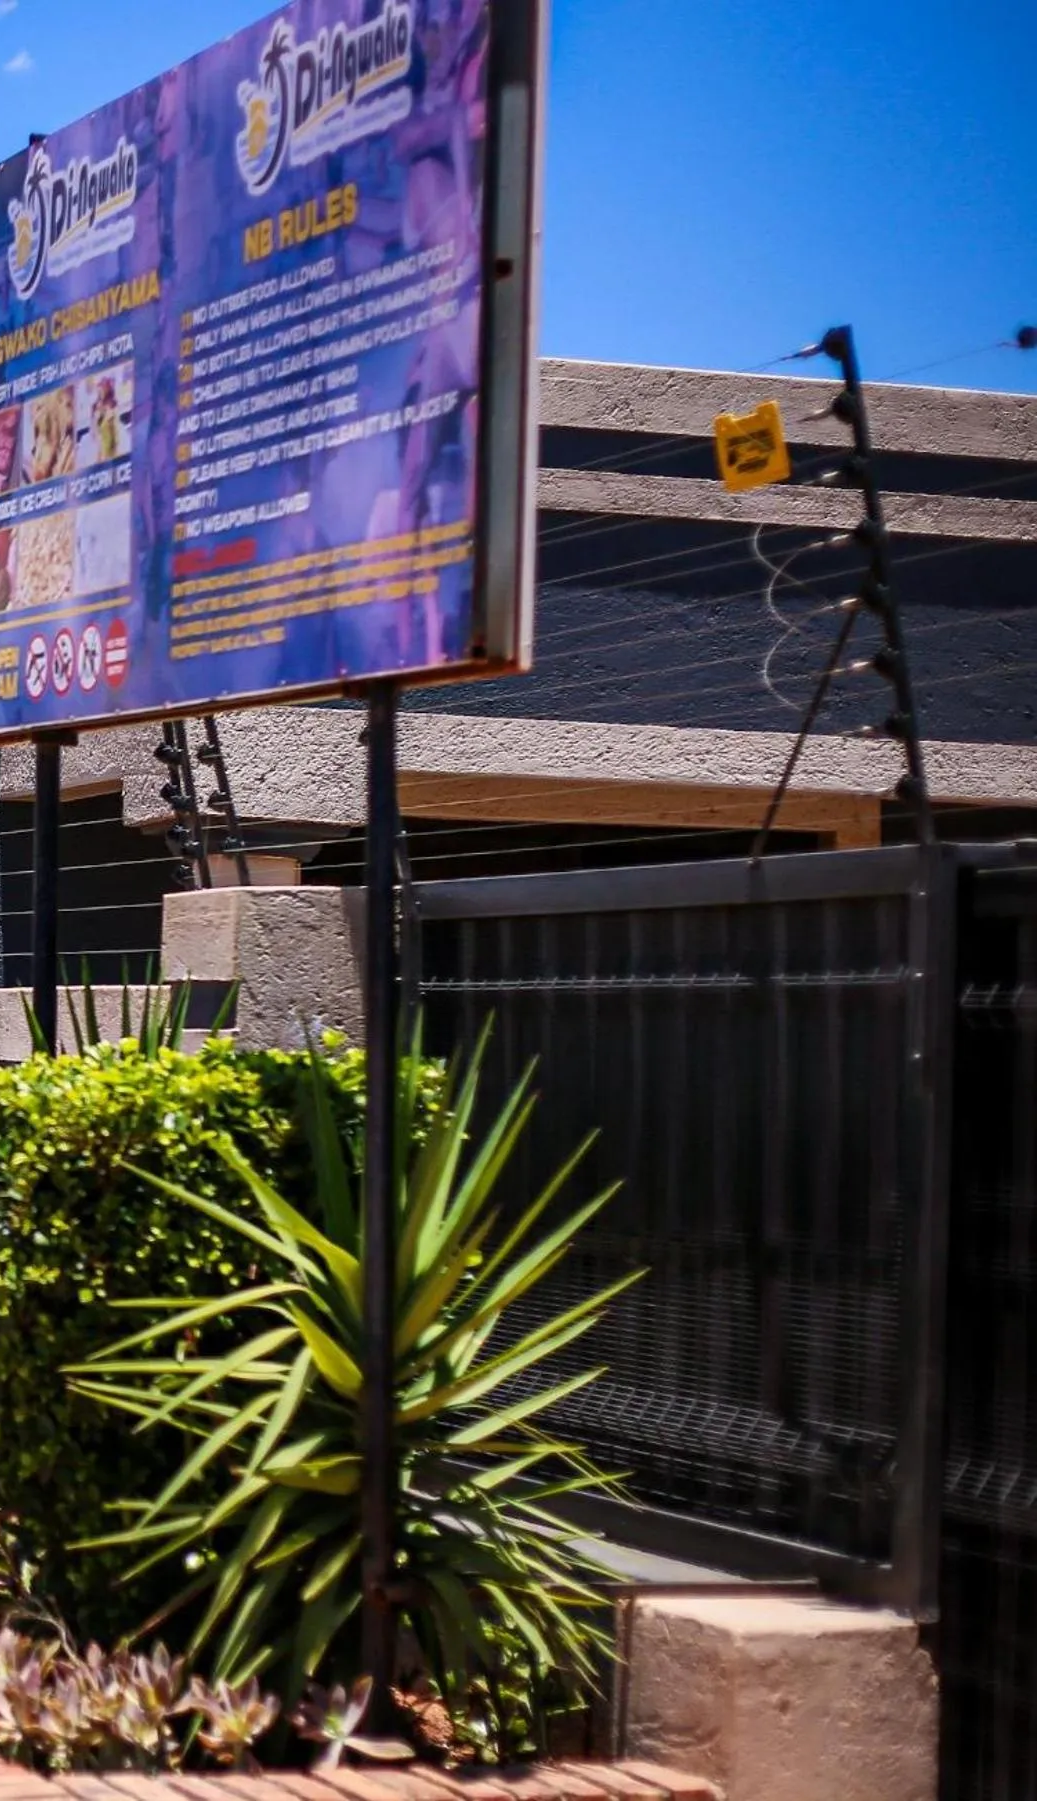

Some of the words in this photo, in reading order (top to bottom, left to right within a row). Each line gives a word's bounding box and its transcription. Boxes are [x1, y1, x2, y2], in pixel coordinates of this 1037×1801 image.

[244, 218, 272, 263] NB
[279, 181, 356, 250] RULES
[52, 269, 160, 339] CHISANYAMA
[192, 305, 207, 326] NO
[209, 289, 248, 320] OUTSIDE
[250, 278, 277, 304] FOOD
[280, 256, 334, 293] ALLOWED
[194, 328, 217, 351] ONLY
[221, 316, 248, 342] SWIM
[250, 304, 281, 331] WEAR
[284, 283, 339, 318] ALLOWED
[354, 254, 415, 293] SWIMMING
[193, 373, 241, 404] CHILDREN
[276, 349, 311, 377] LEAVE
[313, 329, 371, 365] SWIMMING
[374, 315, 411, 345] POOLS
[209, 343, 252, 372] BOTTLES
[254, 323, 307, 357] ALLOWED
[309, 312, 339, 338] NEAR
[177, 414, 199, 435] AND
[216, 398, 250, 423] LEAVE
[310, 375, 324, 395] AT
[191, 438, 205, 457] NO
[286, 407, 309, 430] AND
[311, 392, 358, 422] OUTSIDE
[187, 519, 201, 537] NO
[202, 505, 255, 533] WEAPONS
[257, 492, 309, 520] ALLOWED
